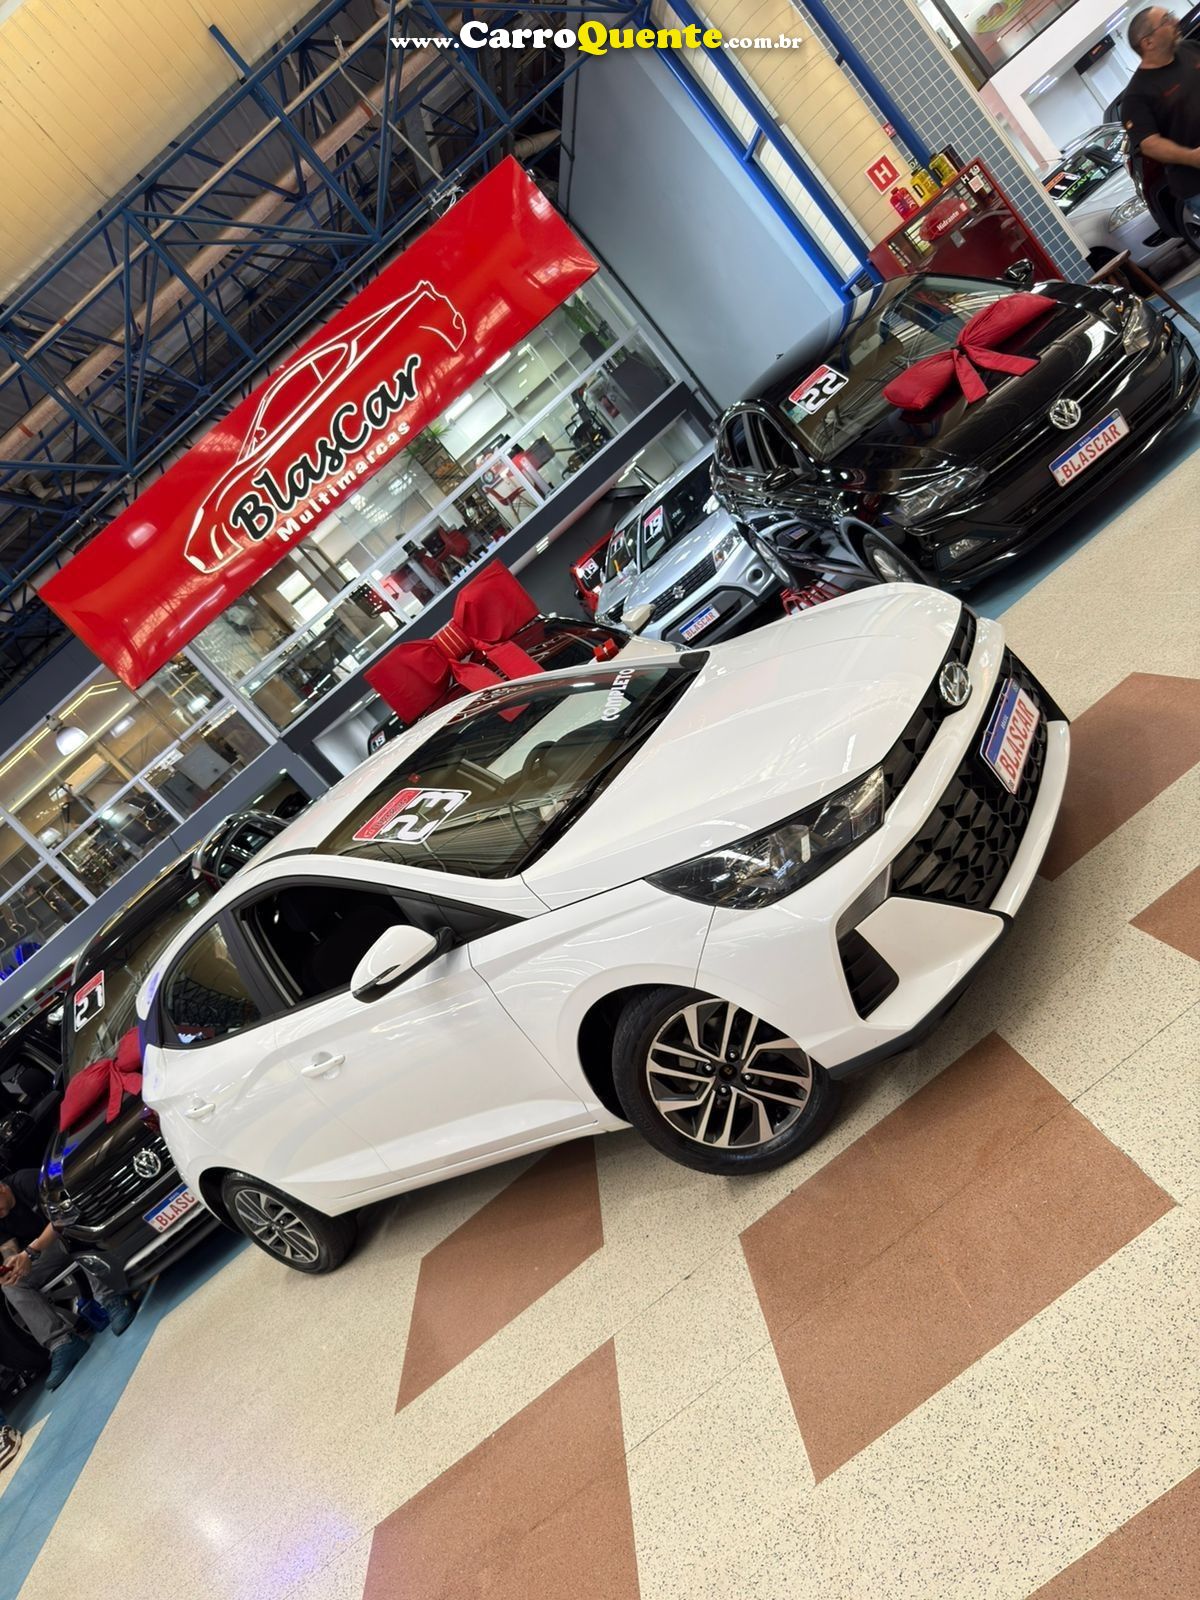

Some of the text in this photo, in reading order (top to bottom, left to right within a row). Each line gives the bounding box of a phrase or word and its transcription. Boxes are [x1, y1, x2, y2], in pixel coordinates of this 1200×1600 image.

[801, 372, 845, 411] 22
[230, 354, 421, 541] BlasCar
[1060, 423, 1121, 480] BLASCAR
[276, 421, 411, 542] Multimarcas
[648, 515, 661, 537] 19
[686, 611, 716, 639] BLASCAR
[601, 668, 636, 721] COMPLETO
[999, 698, 1035, 780] BLASCAR
[380, 791, 465, 841] 23
[76, 984, 103, 1027] 21
